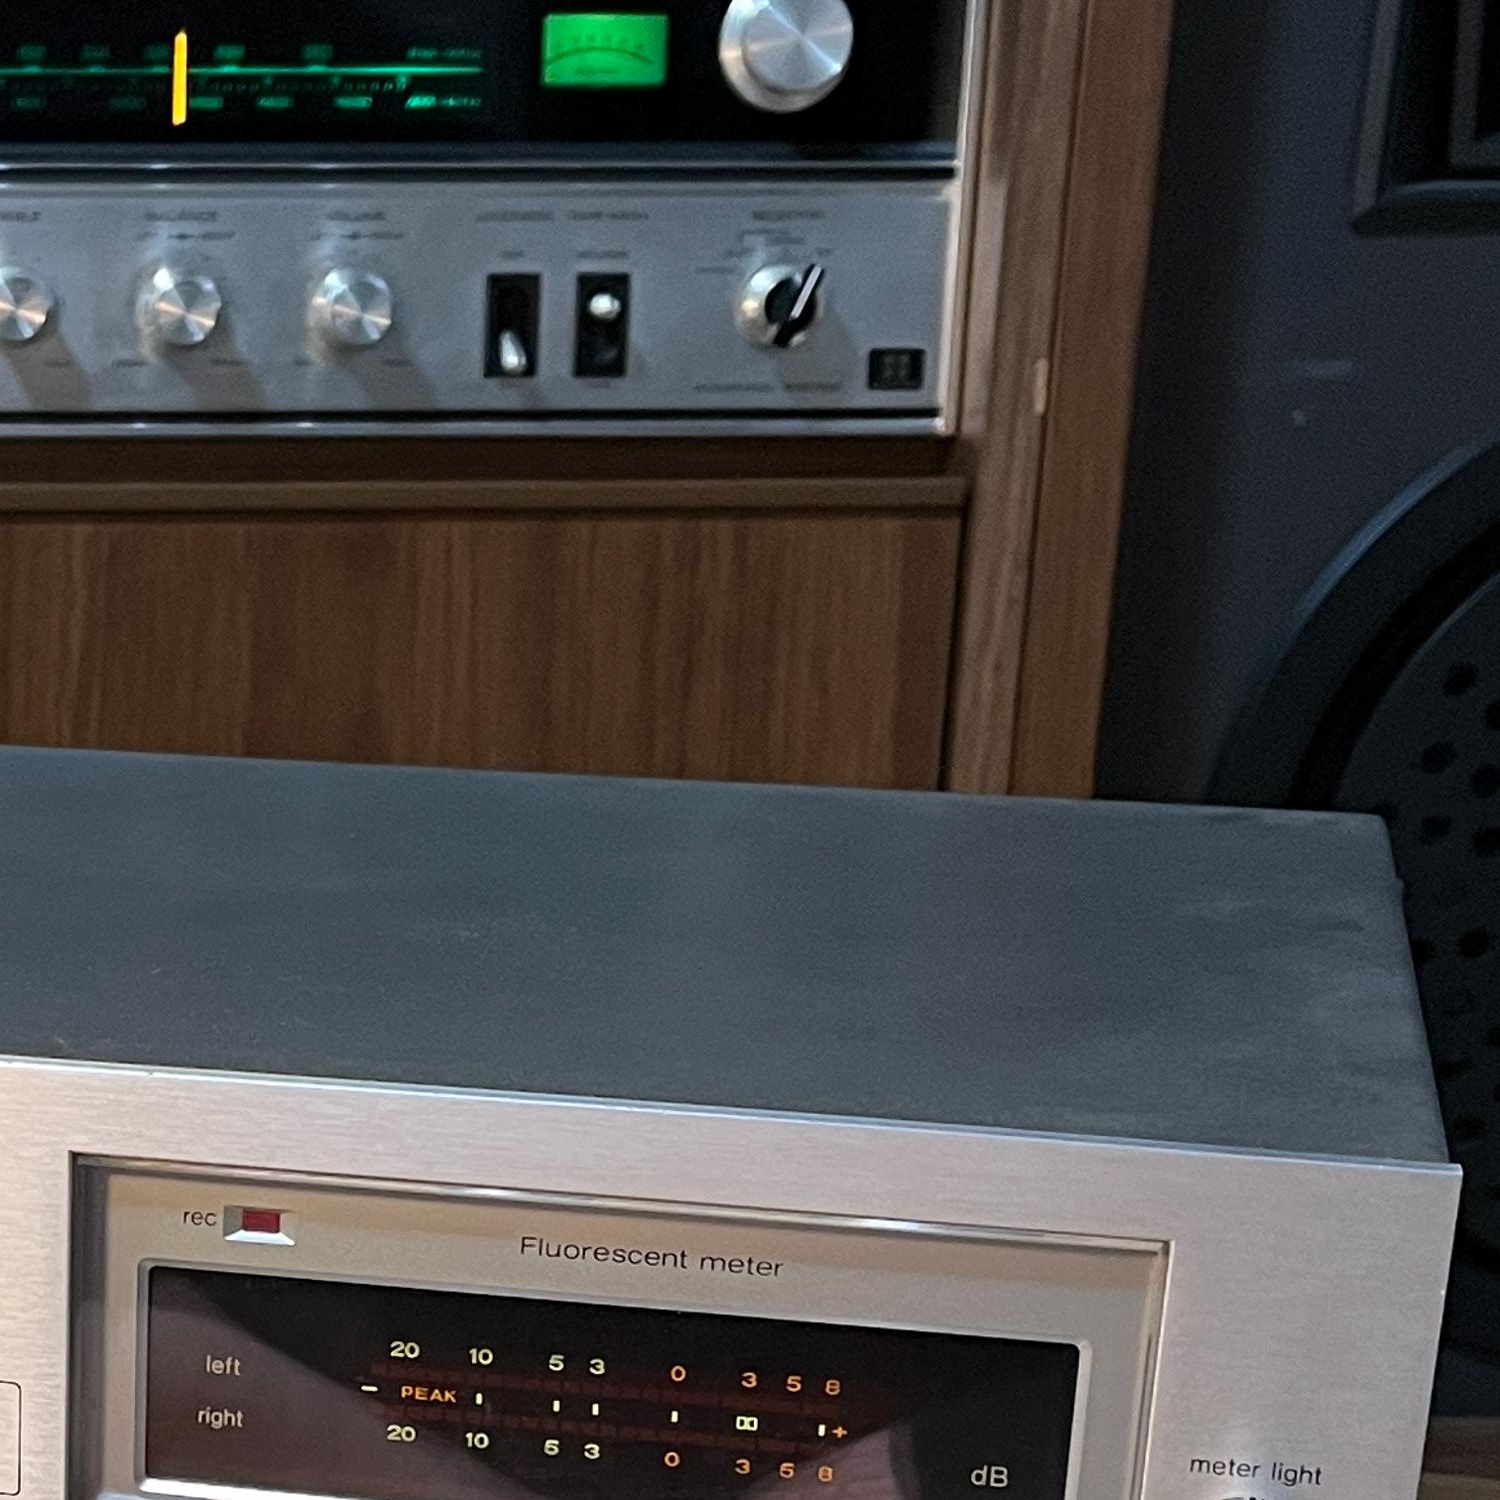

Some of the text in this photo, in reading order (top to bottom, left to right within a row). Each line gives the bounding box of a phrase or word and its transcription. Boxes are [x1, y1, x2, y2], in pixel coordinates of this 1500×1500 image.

[183, 1207, 217, 1228] rec
[520, 1236, 783, 1278] Fluorescent meter
[206, 1355, 241, 1376] left
[390, 1341, 841, 1396] 20 10 5 3 0 3 5 8
[401, 1386, 457, 1403] PEAK
[197, 1407, 243, 1428] right
[387, 1424, 416, 1442] 20
[465, 1432, 490, 1449] 10
[584, 1443, 600, 1459] 3
[664, 1451, 680, 1467] 0
[735, 1459, 751, 1475] 3
[818, 1466, 833, 1483] 8
[970, 1465, 1009, 1488] dB
[1189, 1458, 1322, 1486] meter light
